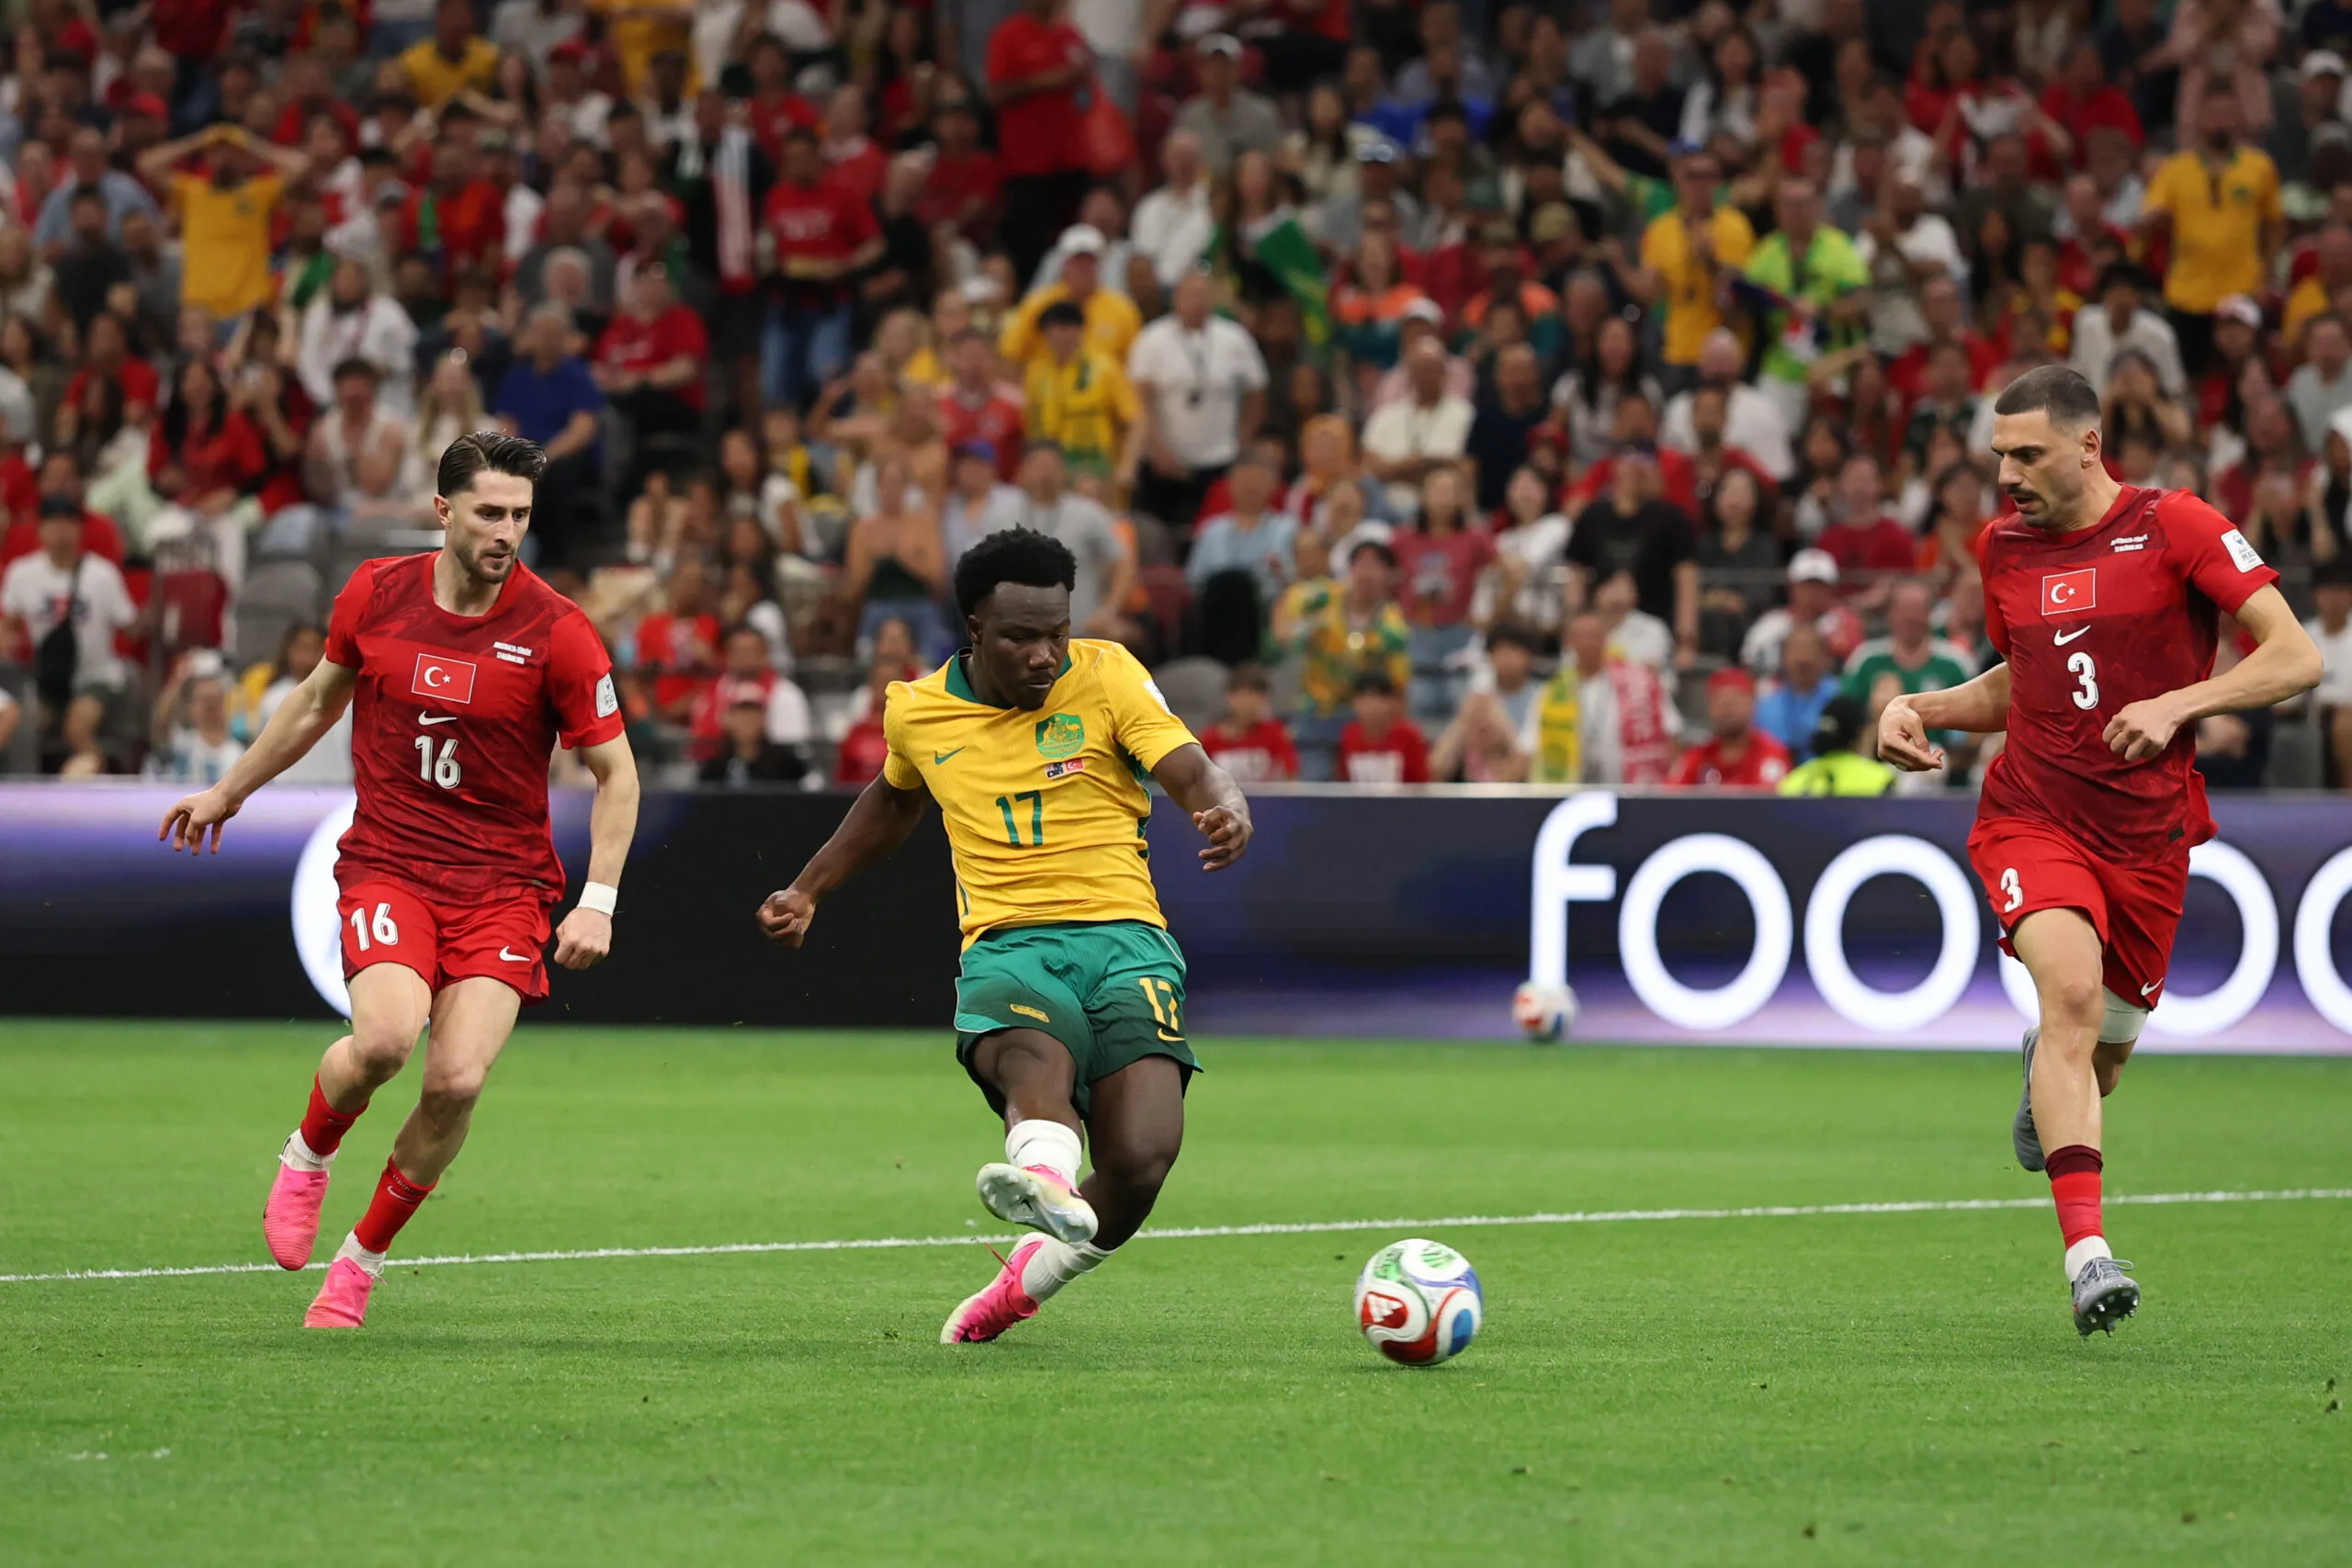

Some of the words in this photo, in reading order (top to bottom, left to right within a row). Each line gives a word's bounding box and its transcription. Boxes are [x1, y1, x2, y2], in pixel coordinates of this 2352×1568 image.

[2067, 651, 2099, 710] 3
[414, 734, 461, 789] 16
[995, 790, 1043, 848] 17
[1998, 867, 2024, 913] 3
[350, 902, 399, 952] 16
[1138, 976, 1179, 1032] 17
